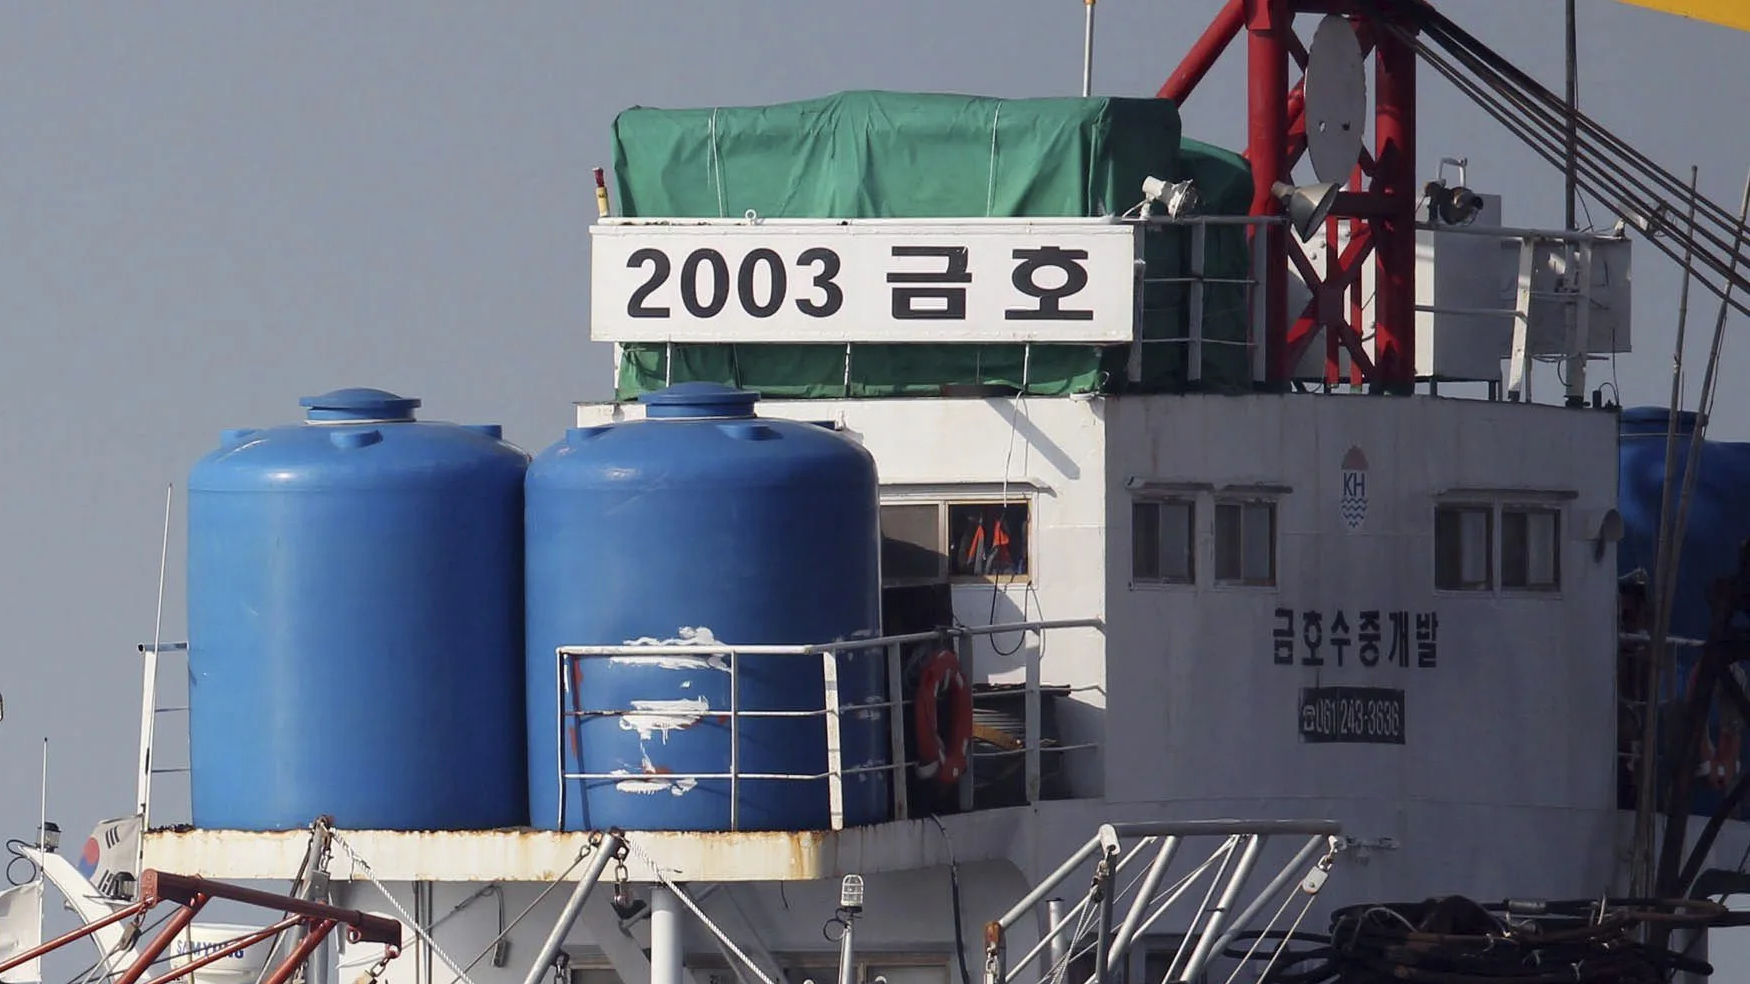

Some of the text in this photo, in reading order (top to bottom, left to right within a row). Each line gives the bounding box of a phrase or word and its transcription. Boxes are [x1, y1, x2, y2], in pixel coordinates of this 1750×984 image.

[625, 247, 844, 319] 2003
[1343, 472, 1366, 497] KH
[1273, 607, 1439, 669] 금호수중개발
